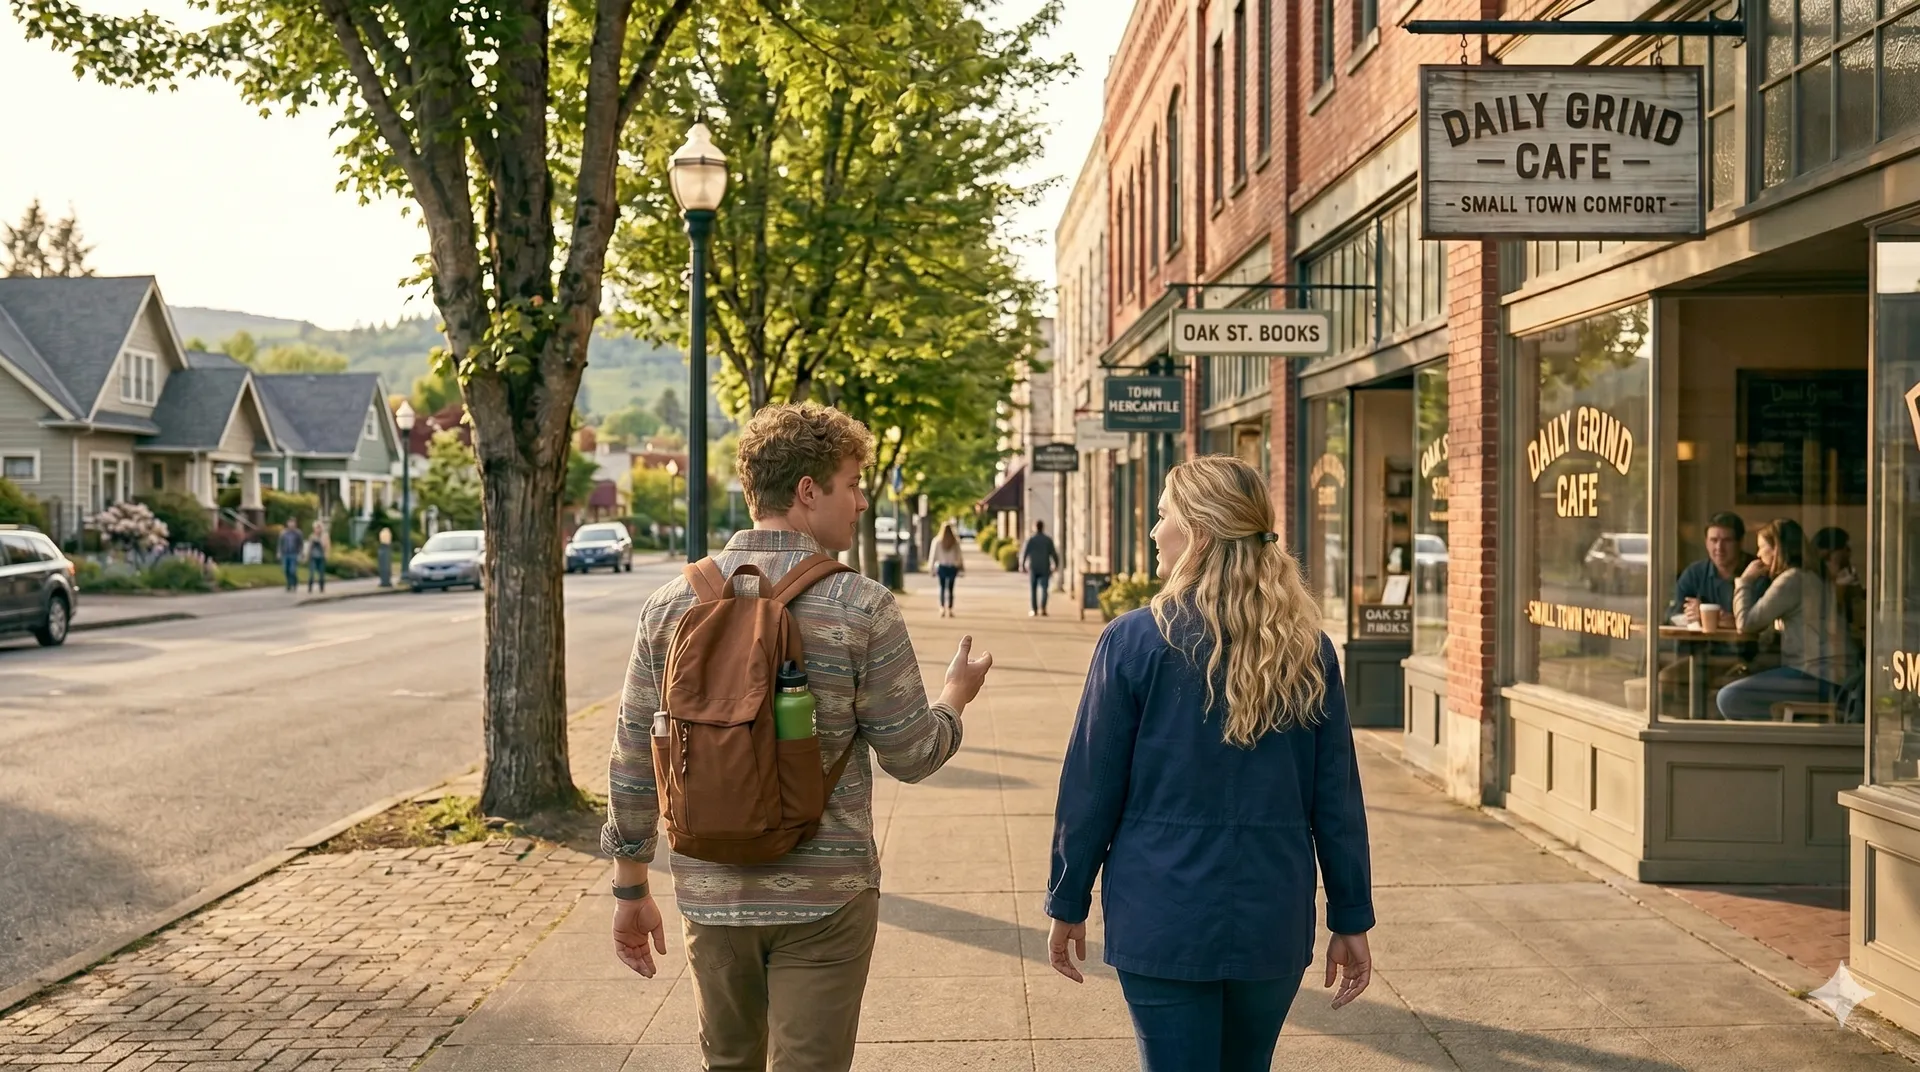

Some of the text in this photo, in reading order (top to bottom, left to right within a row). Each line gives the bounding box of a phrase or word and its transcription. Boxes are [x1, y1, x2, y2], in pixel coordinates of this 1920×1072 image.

[1441, 92, 1684, 148] DAILY GRIND
[1516, 142, 1611, 179] CAFE
[1461, 195, 1667, 214] SMALL TOWN COMFORT
[1183, 323, 1320, 343] OAK ST. BOOKS
[1126, 385, 1162, 399] TOWN
[1108, 400, 1180, 414] MERCANTILE
[1527, 406, 1633, 483] DAILY GRIND
[1556, 472, 1598, 518] CAFE
[1365, 609, 1410, 620] OAK ST
[1528, 600, 1556, 629] SMALL
[1556, 604, 1582, 632] TOWN
